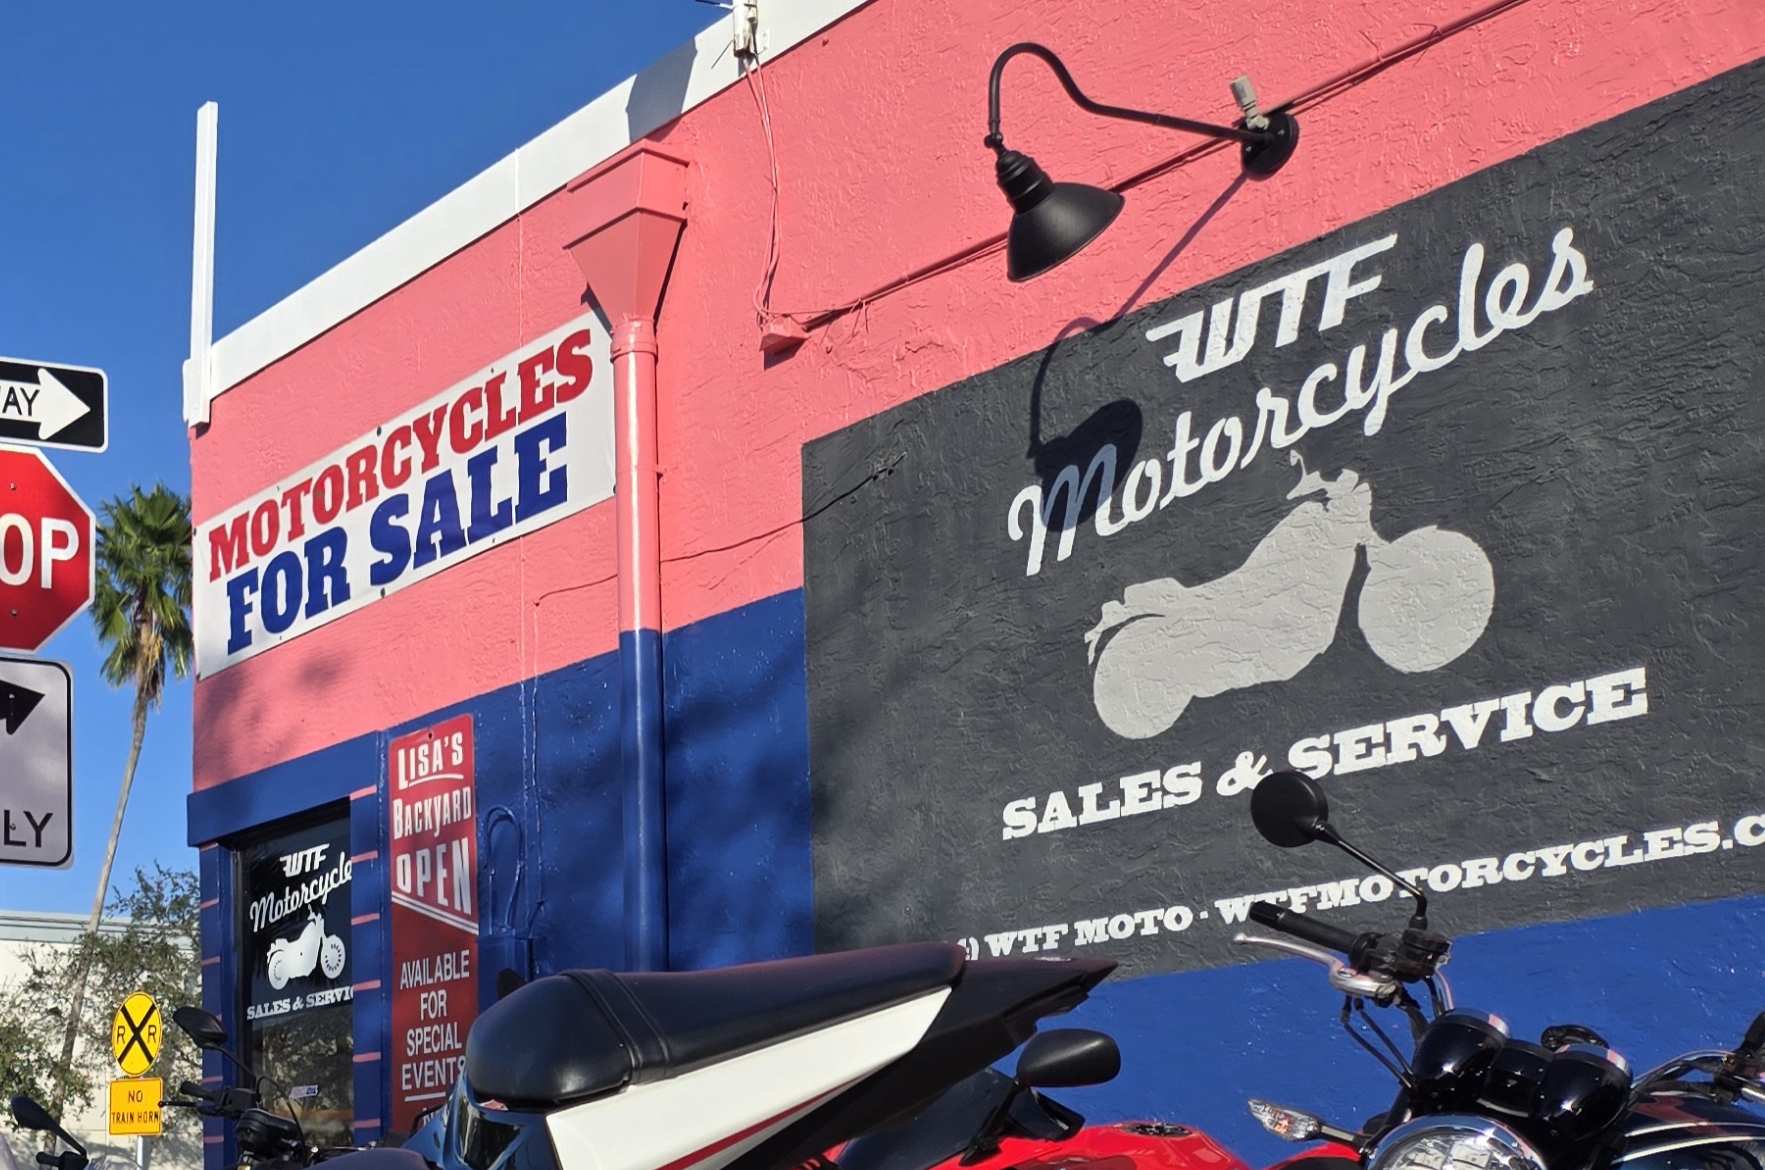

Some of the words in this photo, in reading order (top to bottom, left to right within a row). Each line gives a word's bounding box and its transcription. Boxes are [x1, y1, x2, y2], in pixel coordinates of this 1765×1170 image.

[1146, 233, 1398, 384] WTF
[1007, 226, 1595, 576] Motorcycles
[208, 328, 594, 582] MOTORCYCLES
[227, 525, 352, 655] FOR
[369, 411, 568, 586] SALE
[398, 732, 464, 790] LISA'S
[1002, 761, 1203, 840] SALES
[1288, 667, 1649, 781] SERVICE
[280, 843, 330, 878] WTF
[397, 837, 472, 915] OPEN
[984, 924, 1069, 957] WTF
[1074, 906, 1194, 946] MOTO
[400, 949, 470, 990] AVAILABLE
[247, 997, 291, 1021] SALES
[292, 996, 304, 1012] &
[420, 989, 448, 1021] FOR
[406, 1022, 462, 1057] SPECIAL
[111, 1112, 135, 1125] TRAIN
[137, 1111, 160, 1124] HORN
[127, 1090, 143, 1103] NO
